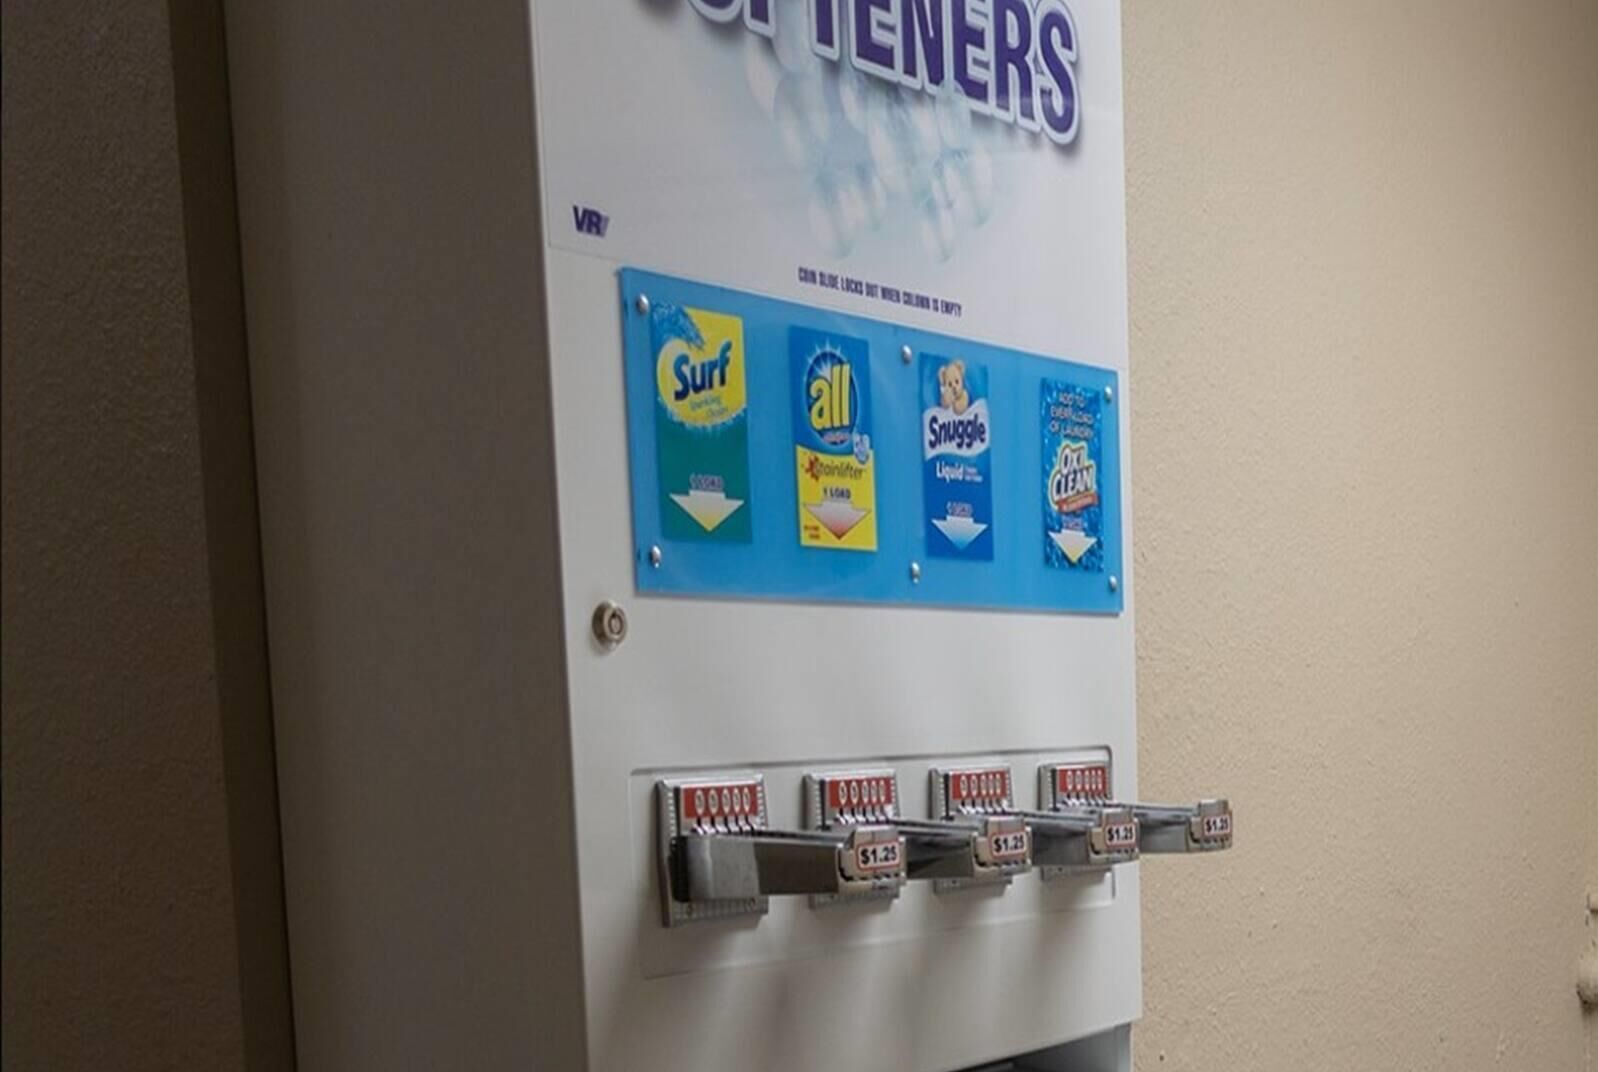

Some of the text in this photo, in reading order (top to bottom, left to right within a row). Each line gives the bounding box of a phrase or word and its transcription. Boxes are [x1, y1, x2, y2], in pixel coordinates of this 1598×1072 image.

[798, 267, 963, 318] COIN SLIDE LOCKS OUT WHEN COLUMN IS EMPTY
[674, 340, 732, 401] Surf
[810, 363, 850, 431] all
[928, 414, 986, 449] Snuggle
[936, 460, 964, 483] Liquid
[1060, 446, 1085, 476] OXI
[831, 488, 852, 500] LOAD
[1052, 465, 1094, 502] CLEAN
[1107, 825, 1134, 843] $1.25
[1205, 815, 1229, 833] $1.25
[860, 847, 898, 865] $1.25
[993, 834, 1025, 854] $1.25
